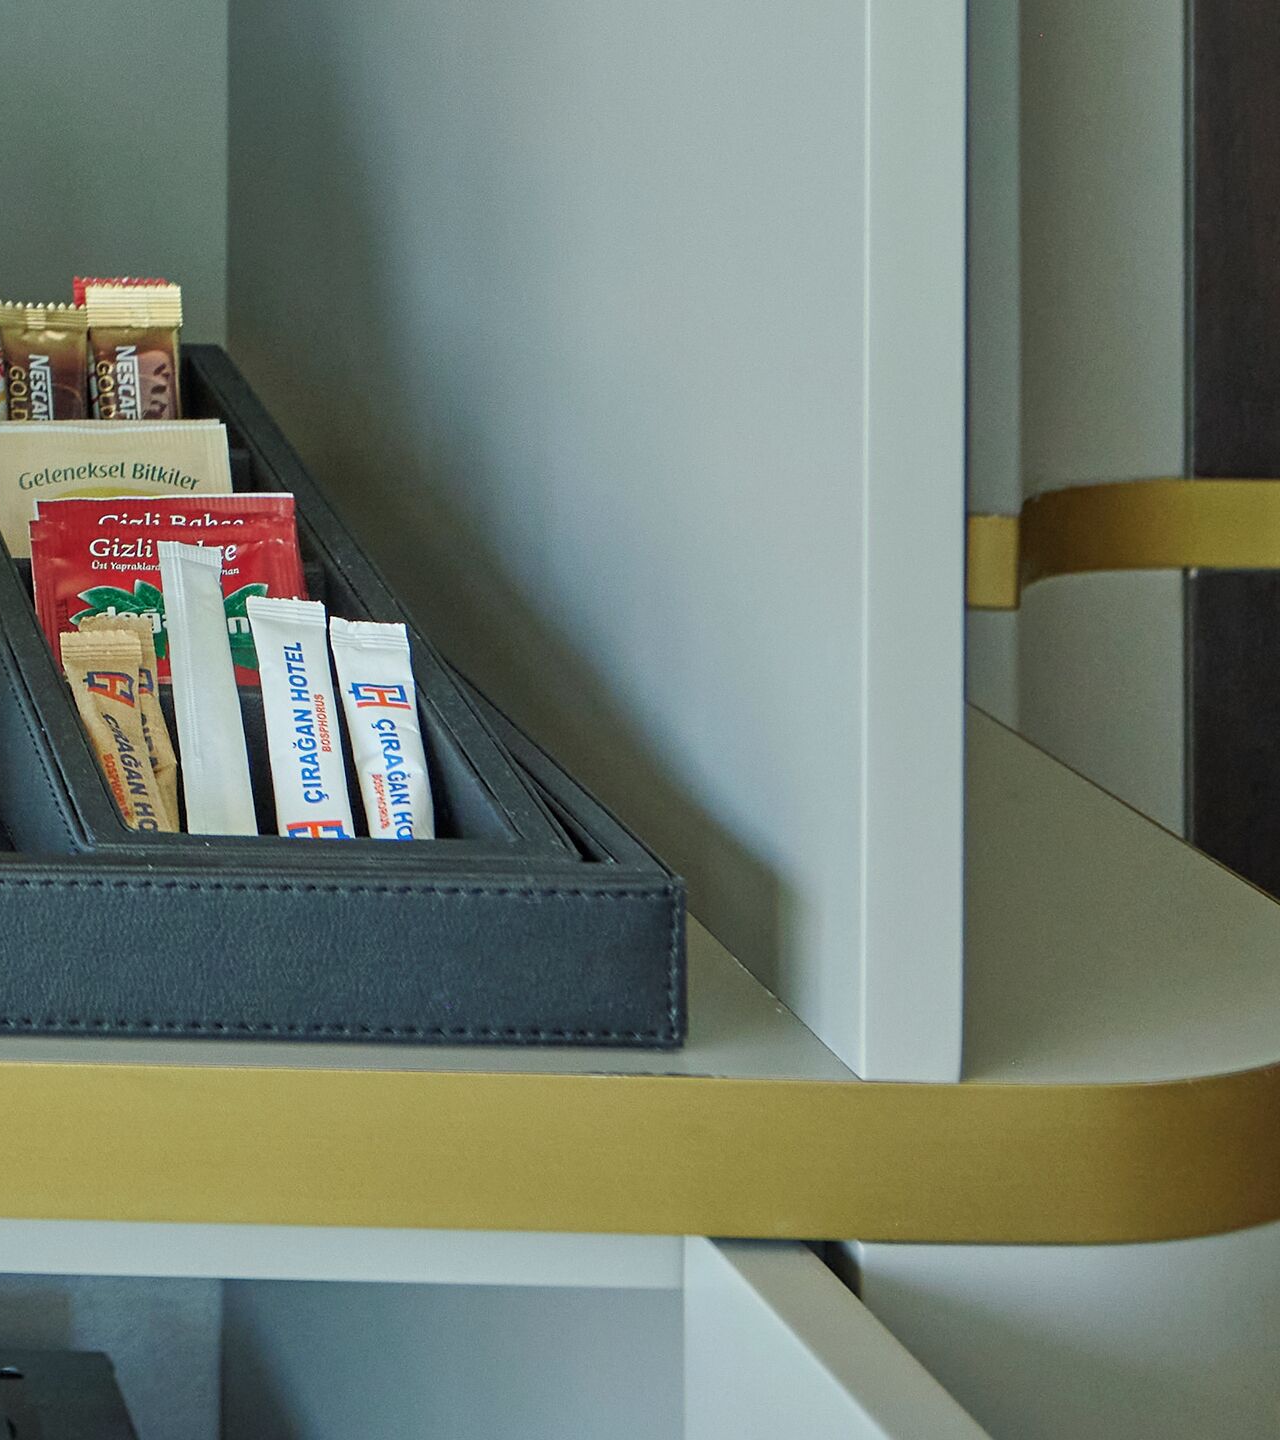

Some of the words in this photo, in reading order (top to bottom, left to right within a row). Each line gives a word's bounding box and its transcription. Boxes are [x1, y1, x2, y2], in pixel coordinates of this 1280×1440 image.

[9, 365, 28, 421] GOLD
[28, 354, 52, 421] NESCAF
[96, 360, 117, 419] GOLD
[115, 345, 139, 420] NESCAF
[18, 462, 126, 490] Geleneksel
[131, 462, 200, 490] Bitkiler
[89, 537, 153, 558] Gizli
[283, 641, 311, 704] HOTEL
[313, 693, 332, 753] BOSPHORUS
[292, 707, 330, 805] ÇIRAĞAN
[371, 718, 412, 806] ÇIRAĞAN
